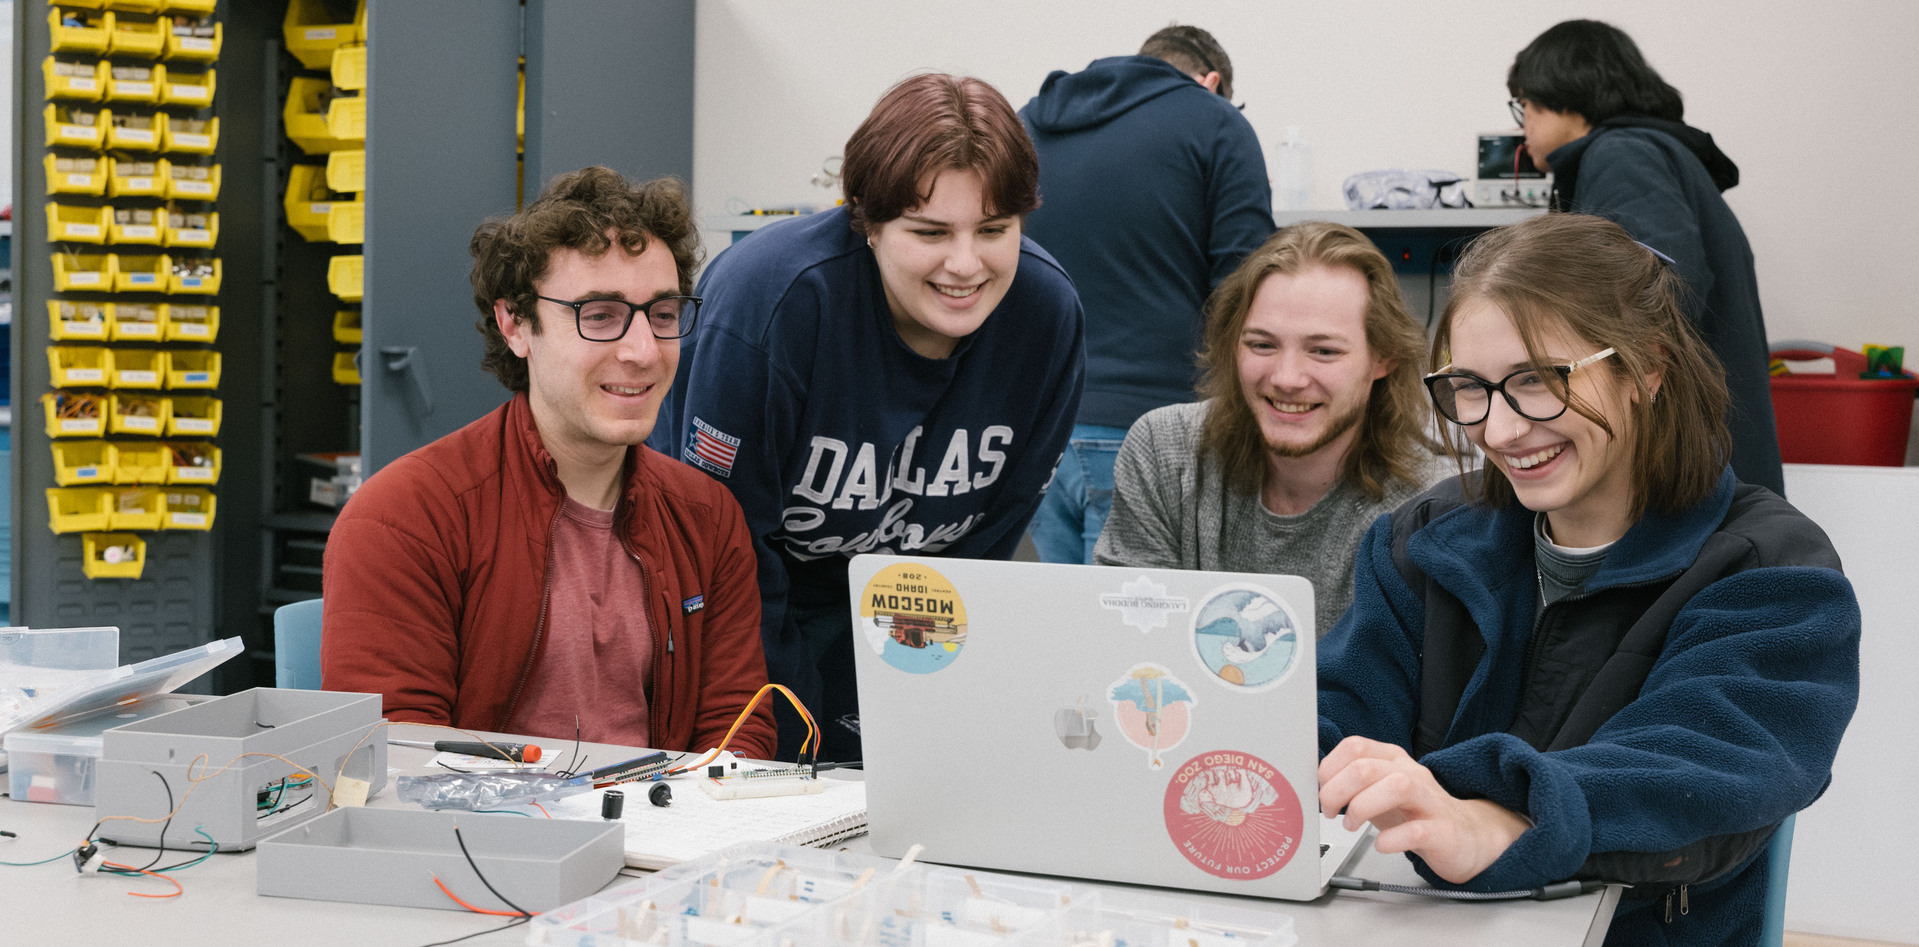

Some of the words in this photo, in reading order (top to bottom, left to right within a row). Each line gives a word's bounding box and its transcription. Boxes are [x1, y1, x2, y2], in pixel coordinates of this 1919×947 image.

[896, 584, 927, 593] IDAHO
[872, 594, 953, 614] MOSCOW
[1141, 601, 1186, 610] LAUGHING
[1204, 754, 1243, 766] DIEGO
[1247, 759, 1274, 779] SAN
[1183, 840, 1221, 870] FUTURE
[1256, 836, 1292, 872] PROTECT
[1226, 865, 1250, 874] OUR
